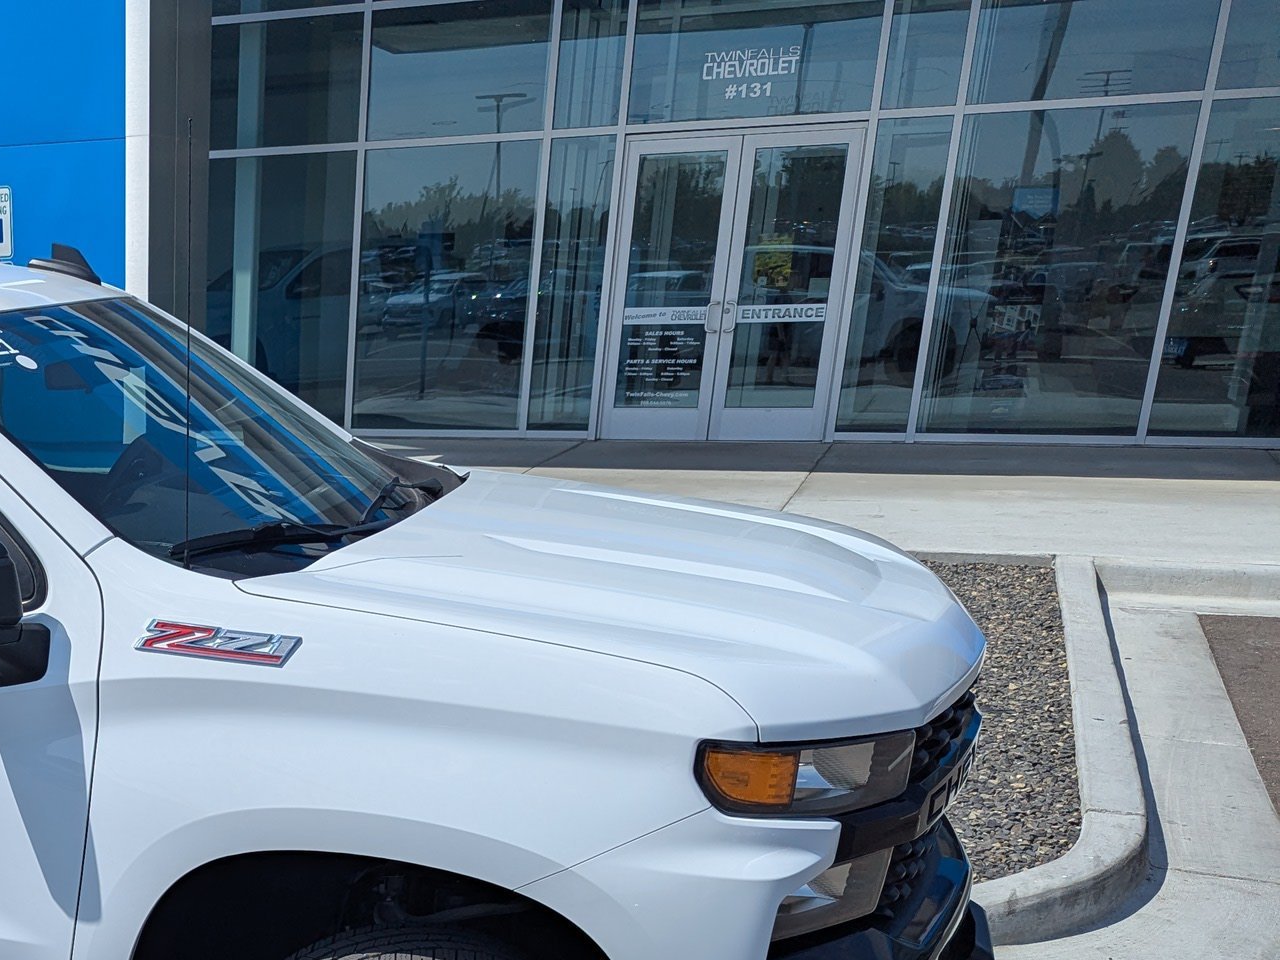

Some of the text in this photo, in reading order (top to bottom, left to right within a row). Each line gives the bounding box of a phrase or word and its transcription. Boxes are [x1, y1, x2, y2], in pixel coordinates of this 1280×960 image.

[704, 45, 801, 63] TWINFALLS
[702, 56, 800, 81] CHEVROLET
[724, 82, 772, 100] #131
[624, 312, 657, 321] Welcome
[740, 306, 825, 320] ENTRANCE
[133, 618, 303, 669] Z71
